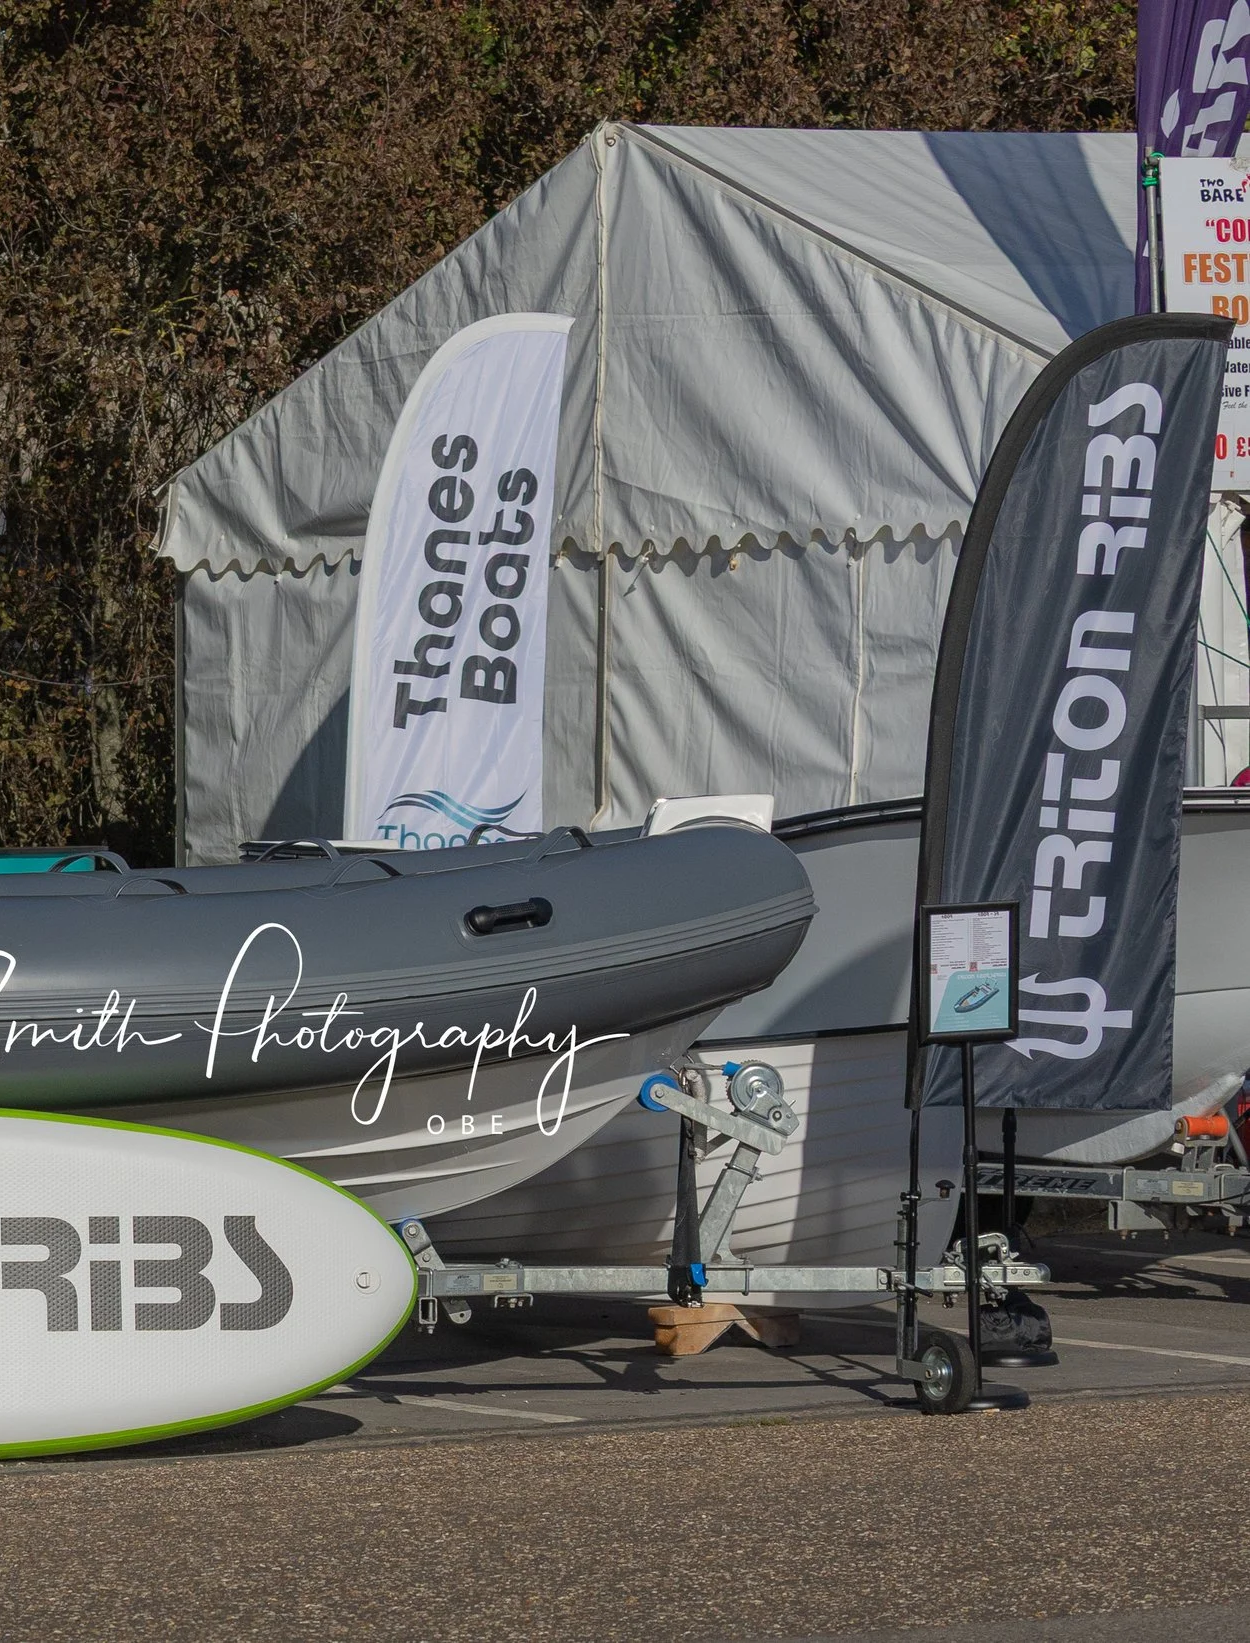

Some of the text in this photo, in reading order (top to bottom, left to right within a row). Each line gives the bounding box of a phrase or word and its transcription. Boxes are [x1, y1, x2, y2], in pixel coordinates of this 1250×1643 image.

[1200, 178, 1224, 187] TWO
[1200, 188, 1244, 202] BARE
[1206, 218, 1250, 243] “CO
[1183, 253, 1250, 283] FEST
[1212, 295, 1250, 325] BO
[393, 433, 478, 730] Thanes
[459, 467, 538, 705] Boats
[1029, 382, 1163, 939] TRITON RIBS
[0, 1215, 294, 1333] RIBS
